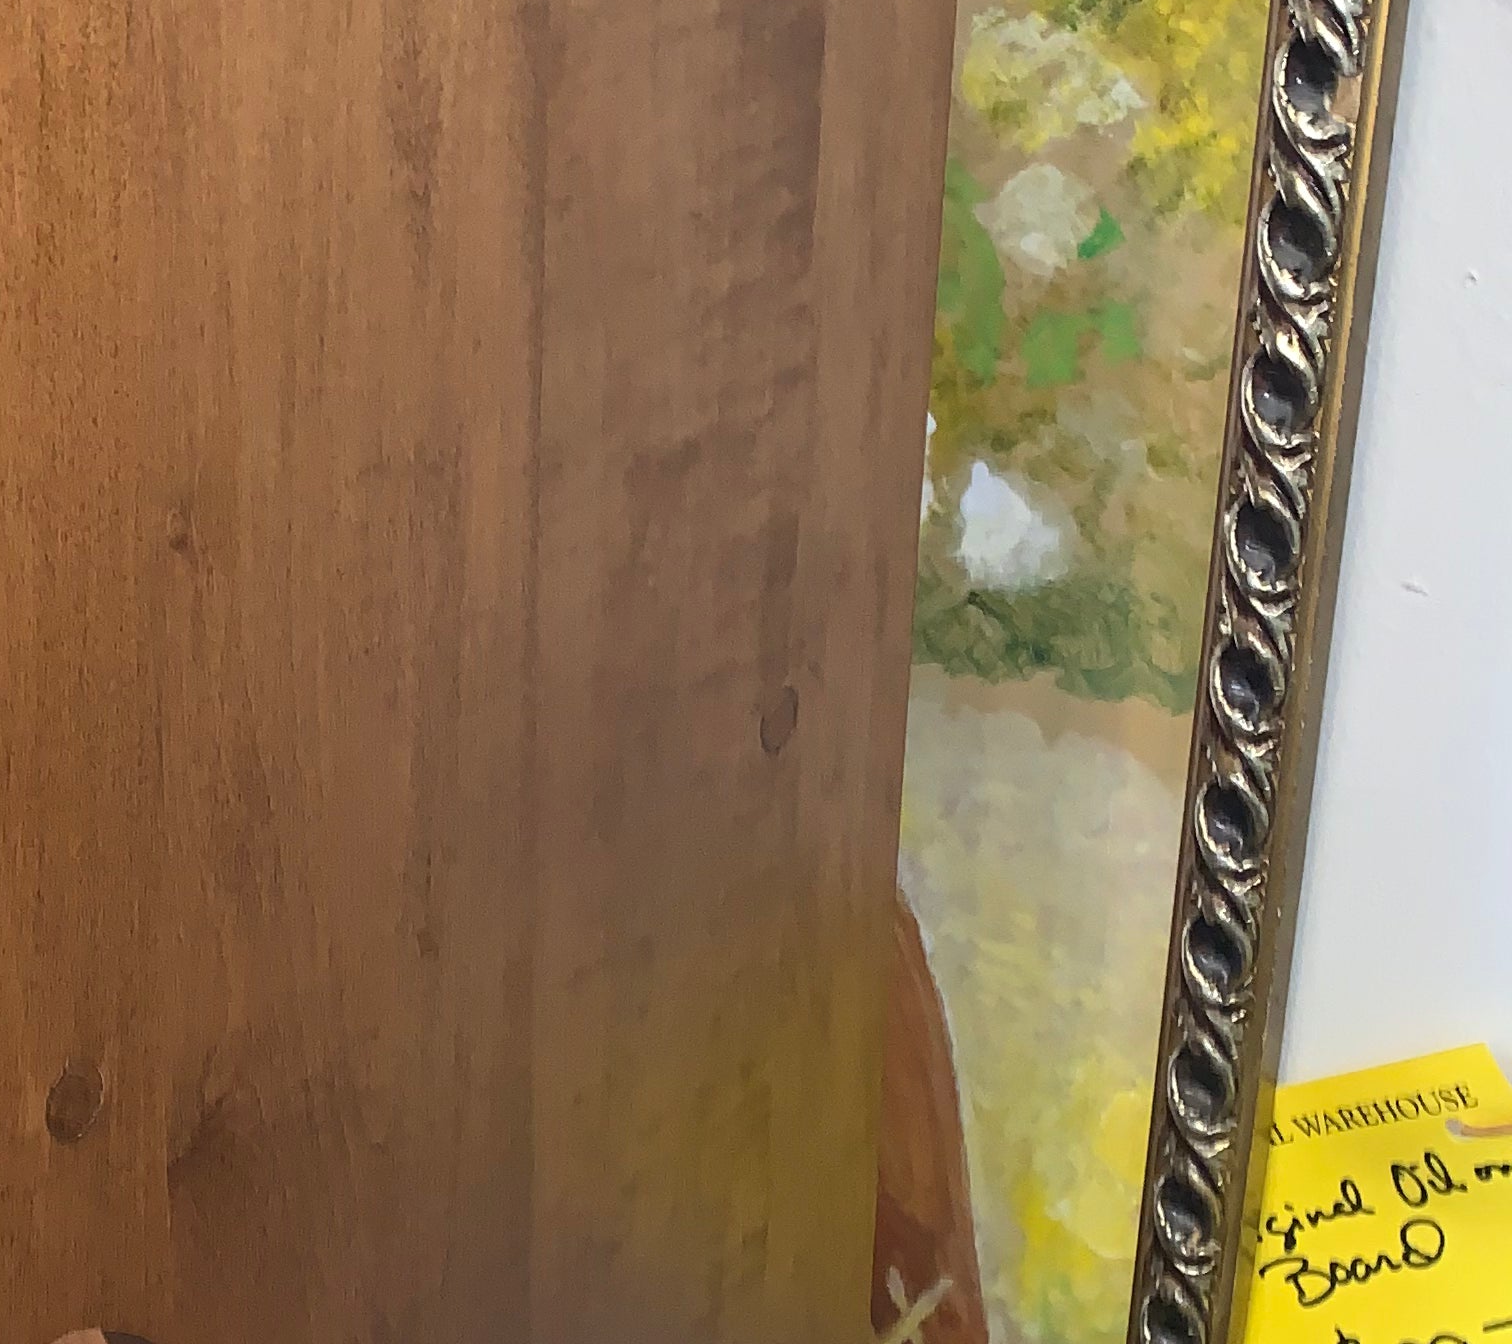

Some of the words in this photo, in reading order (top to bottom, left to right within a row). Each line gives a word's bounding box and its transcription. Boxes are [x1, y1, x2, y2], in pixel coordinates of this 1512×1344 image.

[1292, 1084, 1479, 1139] WAREHOUSE
[1257, 1178, 1376, 1253] ginal
[1391, 1151, 1468, 1207] Oil
[1258, 1218, 1445, 1307] Board
